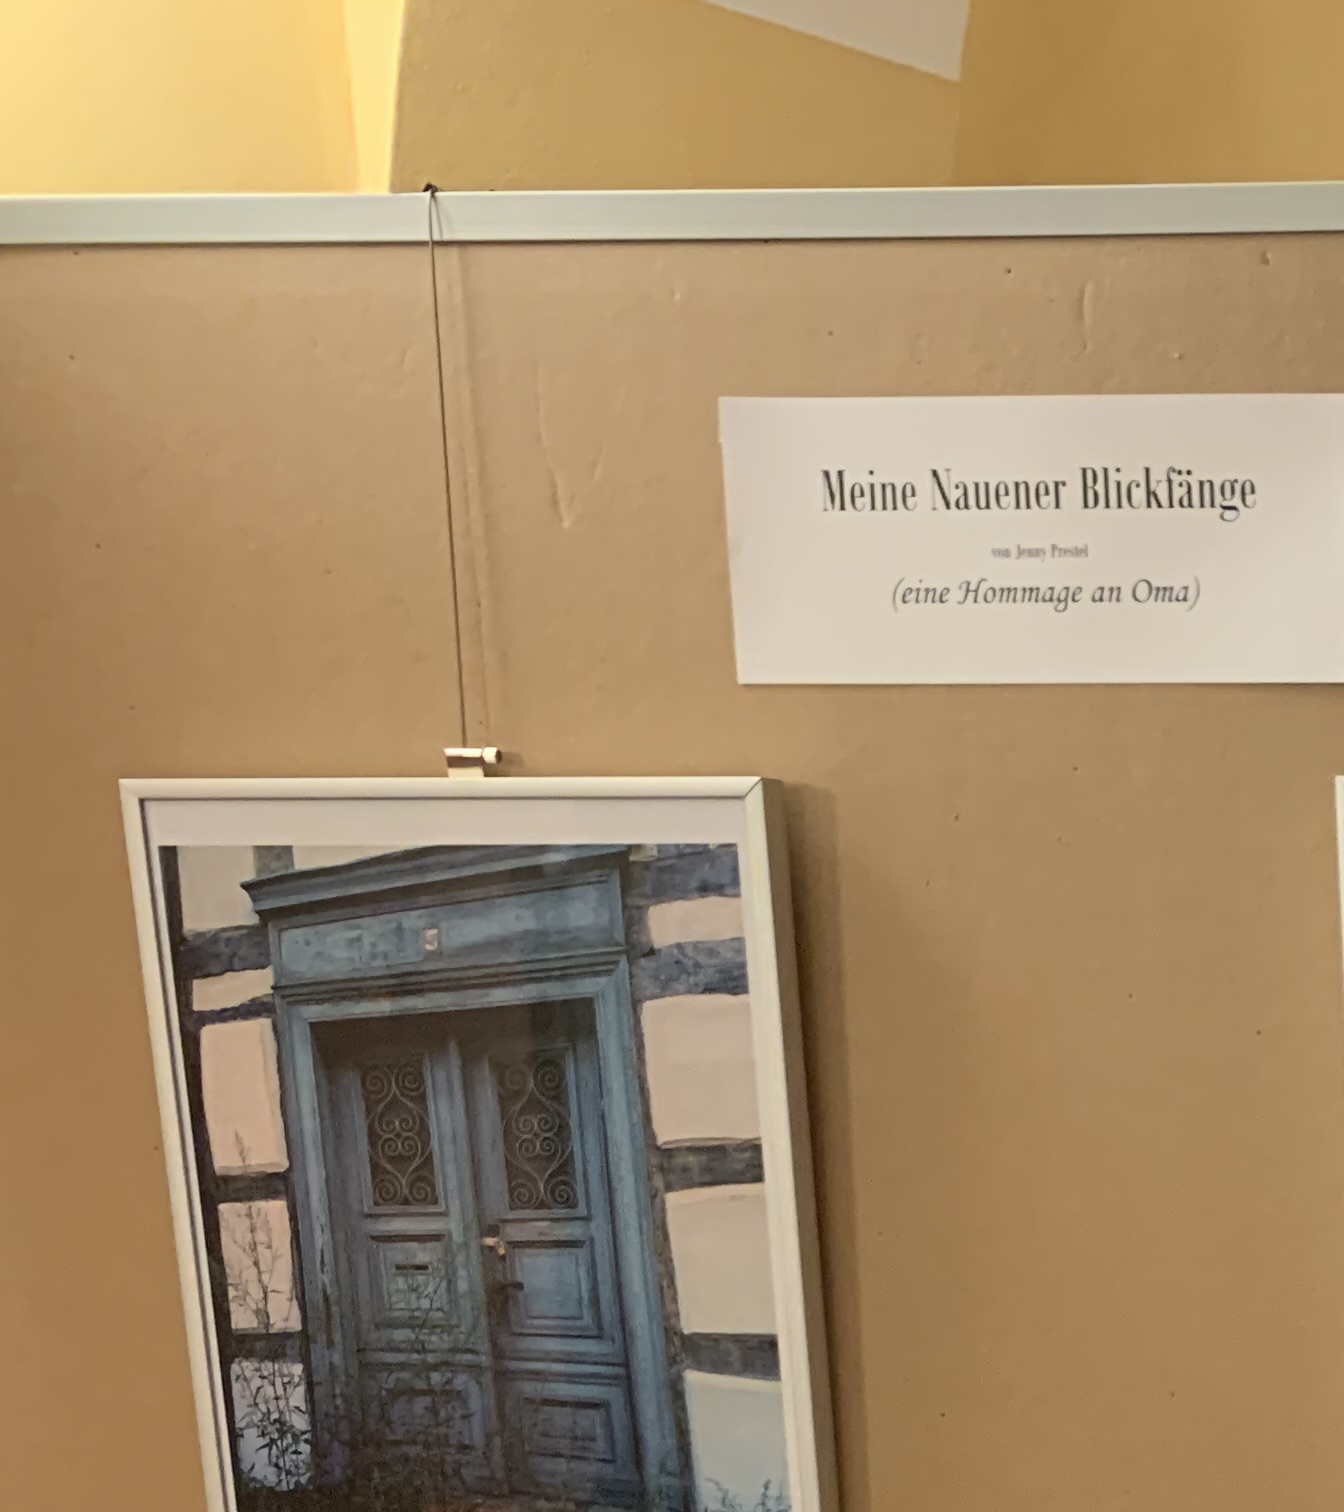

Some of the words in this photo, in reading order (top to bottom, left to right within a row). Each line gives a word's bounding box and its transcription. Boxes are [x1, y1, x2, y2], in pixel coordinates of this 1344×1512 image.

[822, 470, 918, 512] Meine
[929, 468, 1067, 511] Nauener
[1080, 466, 1257, 522] Blickfänge
[892, 577, 951, 612] (eine
[956, 579, 1083, 612] Hommage
[1091, 584, 1123, 603] an
[1131, 576, 1201, 611] Oma)
